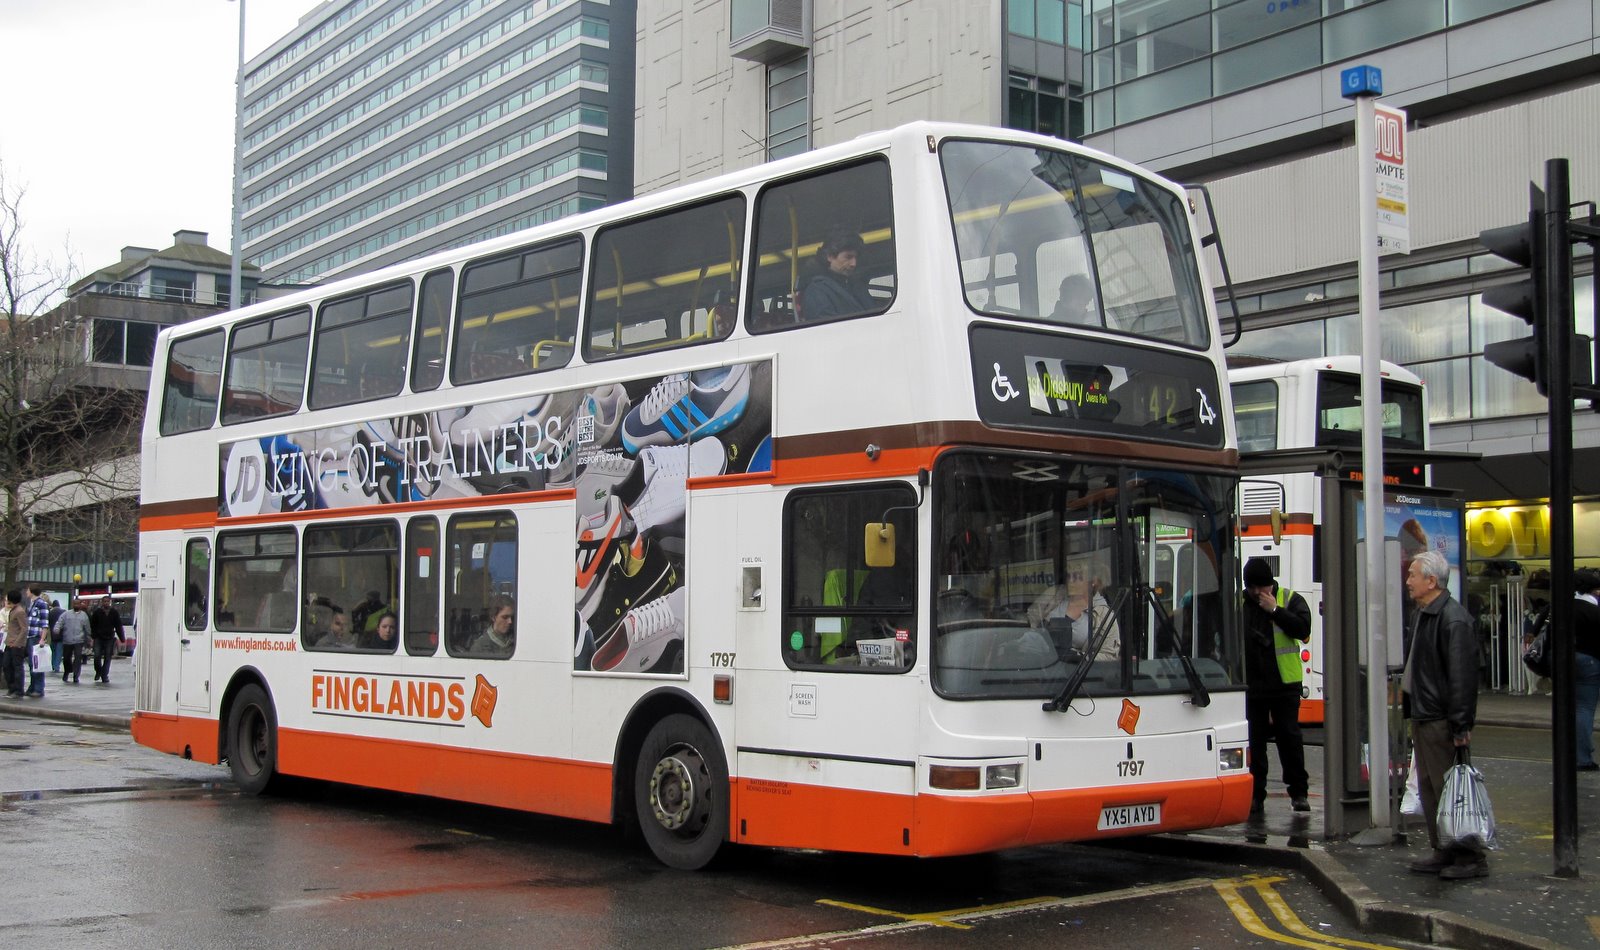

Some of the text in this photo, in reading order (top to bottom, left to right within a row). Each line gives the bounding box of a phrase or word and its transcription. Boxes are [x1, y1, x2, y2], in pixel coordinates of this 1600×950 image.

[1348, 72, 1359, 88] G
[1371, 72, 1379, 87] G
[1043, 372, 1084, 407] Didsbury
[578, 431, 593, 441] BEST
[271, 415, 563, 497] KING OF TRAINERS
[577, 452, 624, 465] JDSPORTS.CO.UK
[230, 455, 261, 505] JD
[1349, 471, 1401, 485] FINNDS
[1395, 495, 1421, 505] JCDecaux
[214, 637, 297, 653] www.finglands.co.uk
[710, 652, 737, 667] 1797
[312, 675, 465, 721] FINGLANDS
[1116, 760, 1145, 777] 1797
[1105, 806, 1155, 827] YX51 AYD
